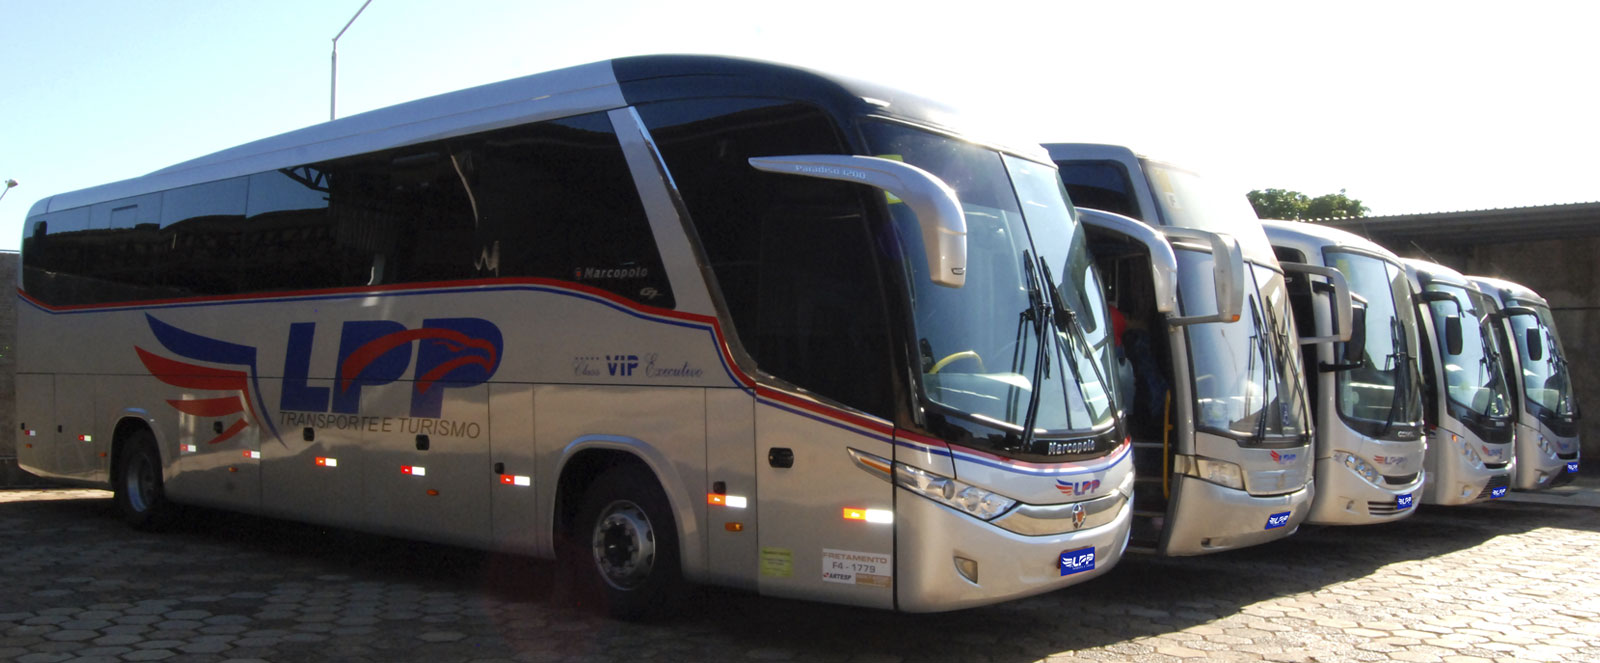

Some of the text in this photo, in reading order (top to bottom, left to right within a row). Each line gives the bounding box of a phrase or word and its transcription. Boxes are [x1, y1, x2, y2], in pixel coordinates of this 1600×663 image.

[795, 164, 866, 180] Paradiso 1200
[583, 266, 649, 280] Marcopolo
[279, 317, 504, 419] LPP
[605, 354, 639, 376] VIP
[279, 410, 480, 440] TRANSPORTE E TURISMO
[1047, 438, 1096, 456] Marcopolo
[1073, 479, 1101, 496] LPP
[823, 552, 888, 565] FRETAMENTO
[1072, 553, 1094, 567] LPP
[832, 561, 844, 570] F4
[851, 563, 876, 574] 1779
[829, 572, 852, 581] ARTESP
